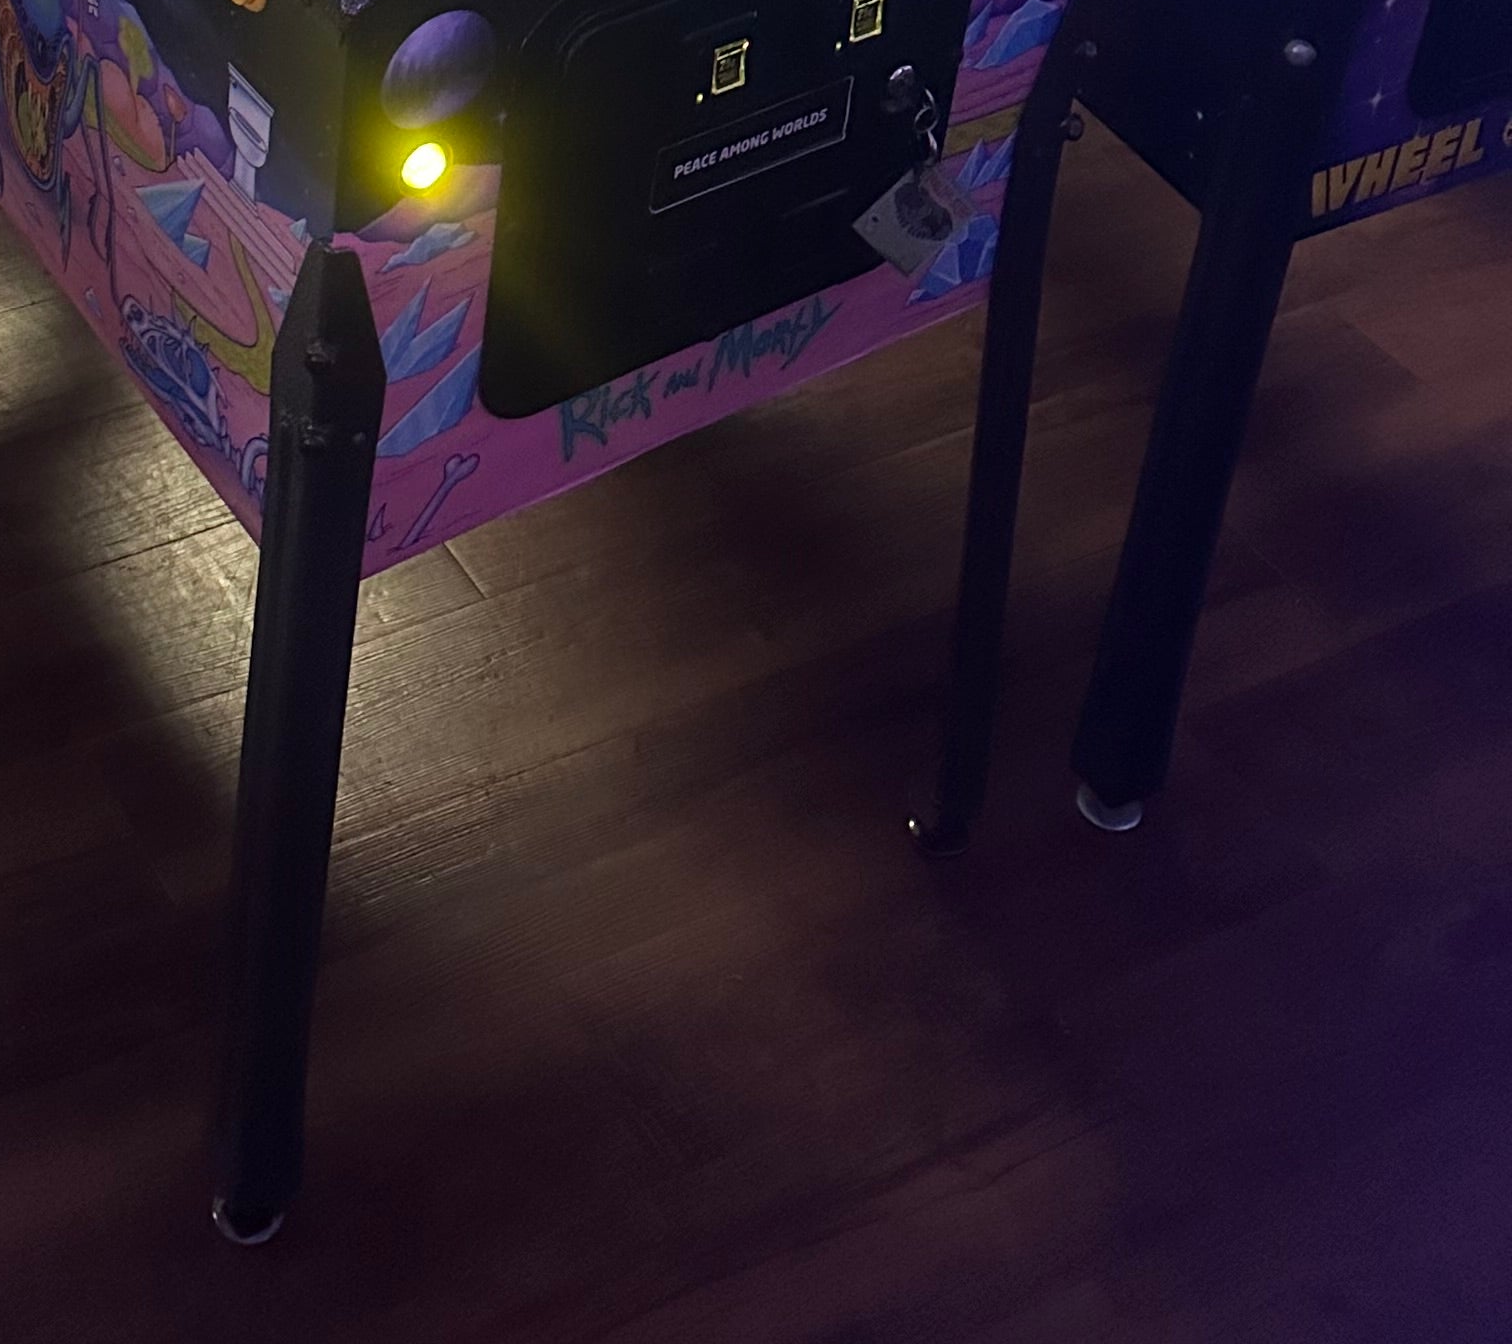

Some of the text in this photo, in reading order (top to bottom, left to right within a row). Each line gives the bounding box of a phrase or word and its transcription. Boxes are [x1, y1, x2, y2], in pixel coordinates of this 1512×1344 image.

[674, 107, 829, 180] PEACE AMONG WORLDS
[1311, 118, 1485, 220] WHEEL
